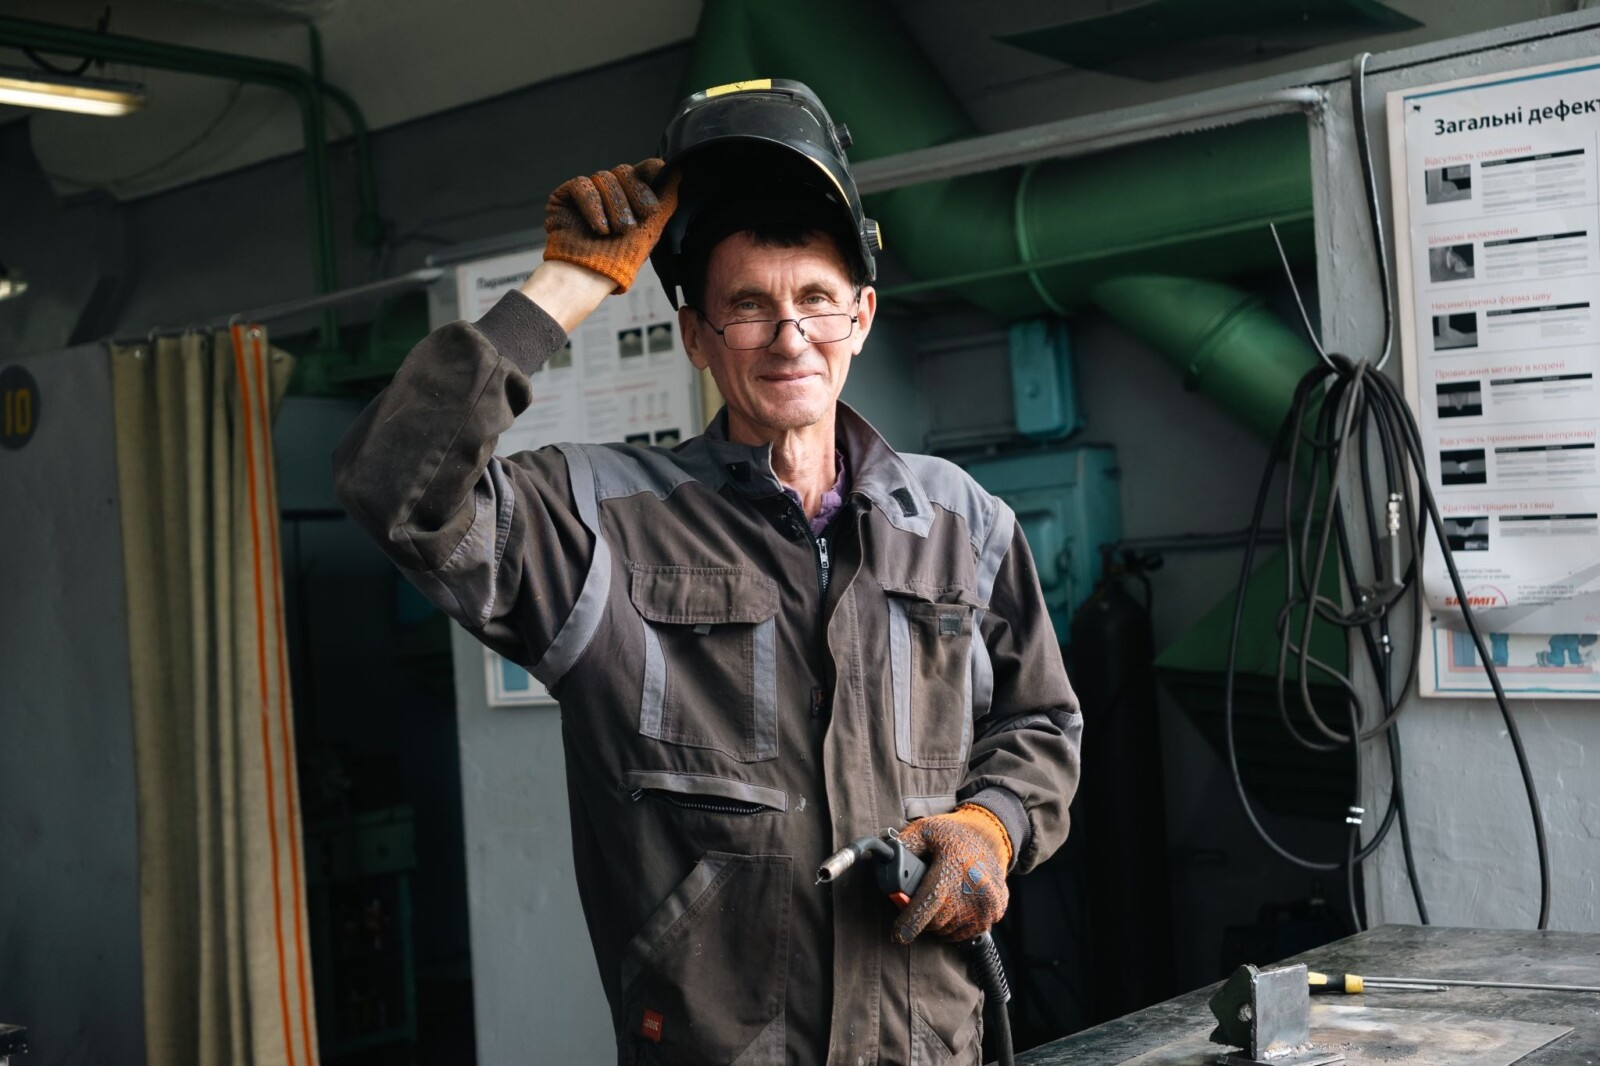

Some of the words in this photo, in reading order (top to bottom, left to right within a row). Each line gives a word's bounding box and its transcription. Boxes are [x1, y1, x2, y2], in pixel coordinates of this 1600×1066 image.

[1434, 106, 1522, 135] Загальні
[1499, 294, 1530, 306] форма
[1435, 367, 1489, 379] Провисання
[1491, 364, 1522, 375] металу
[4, 387, 32, 437] 10
